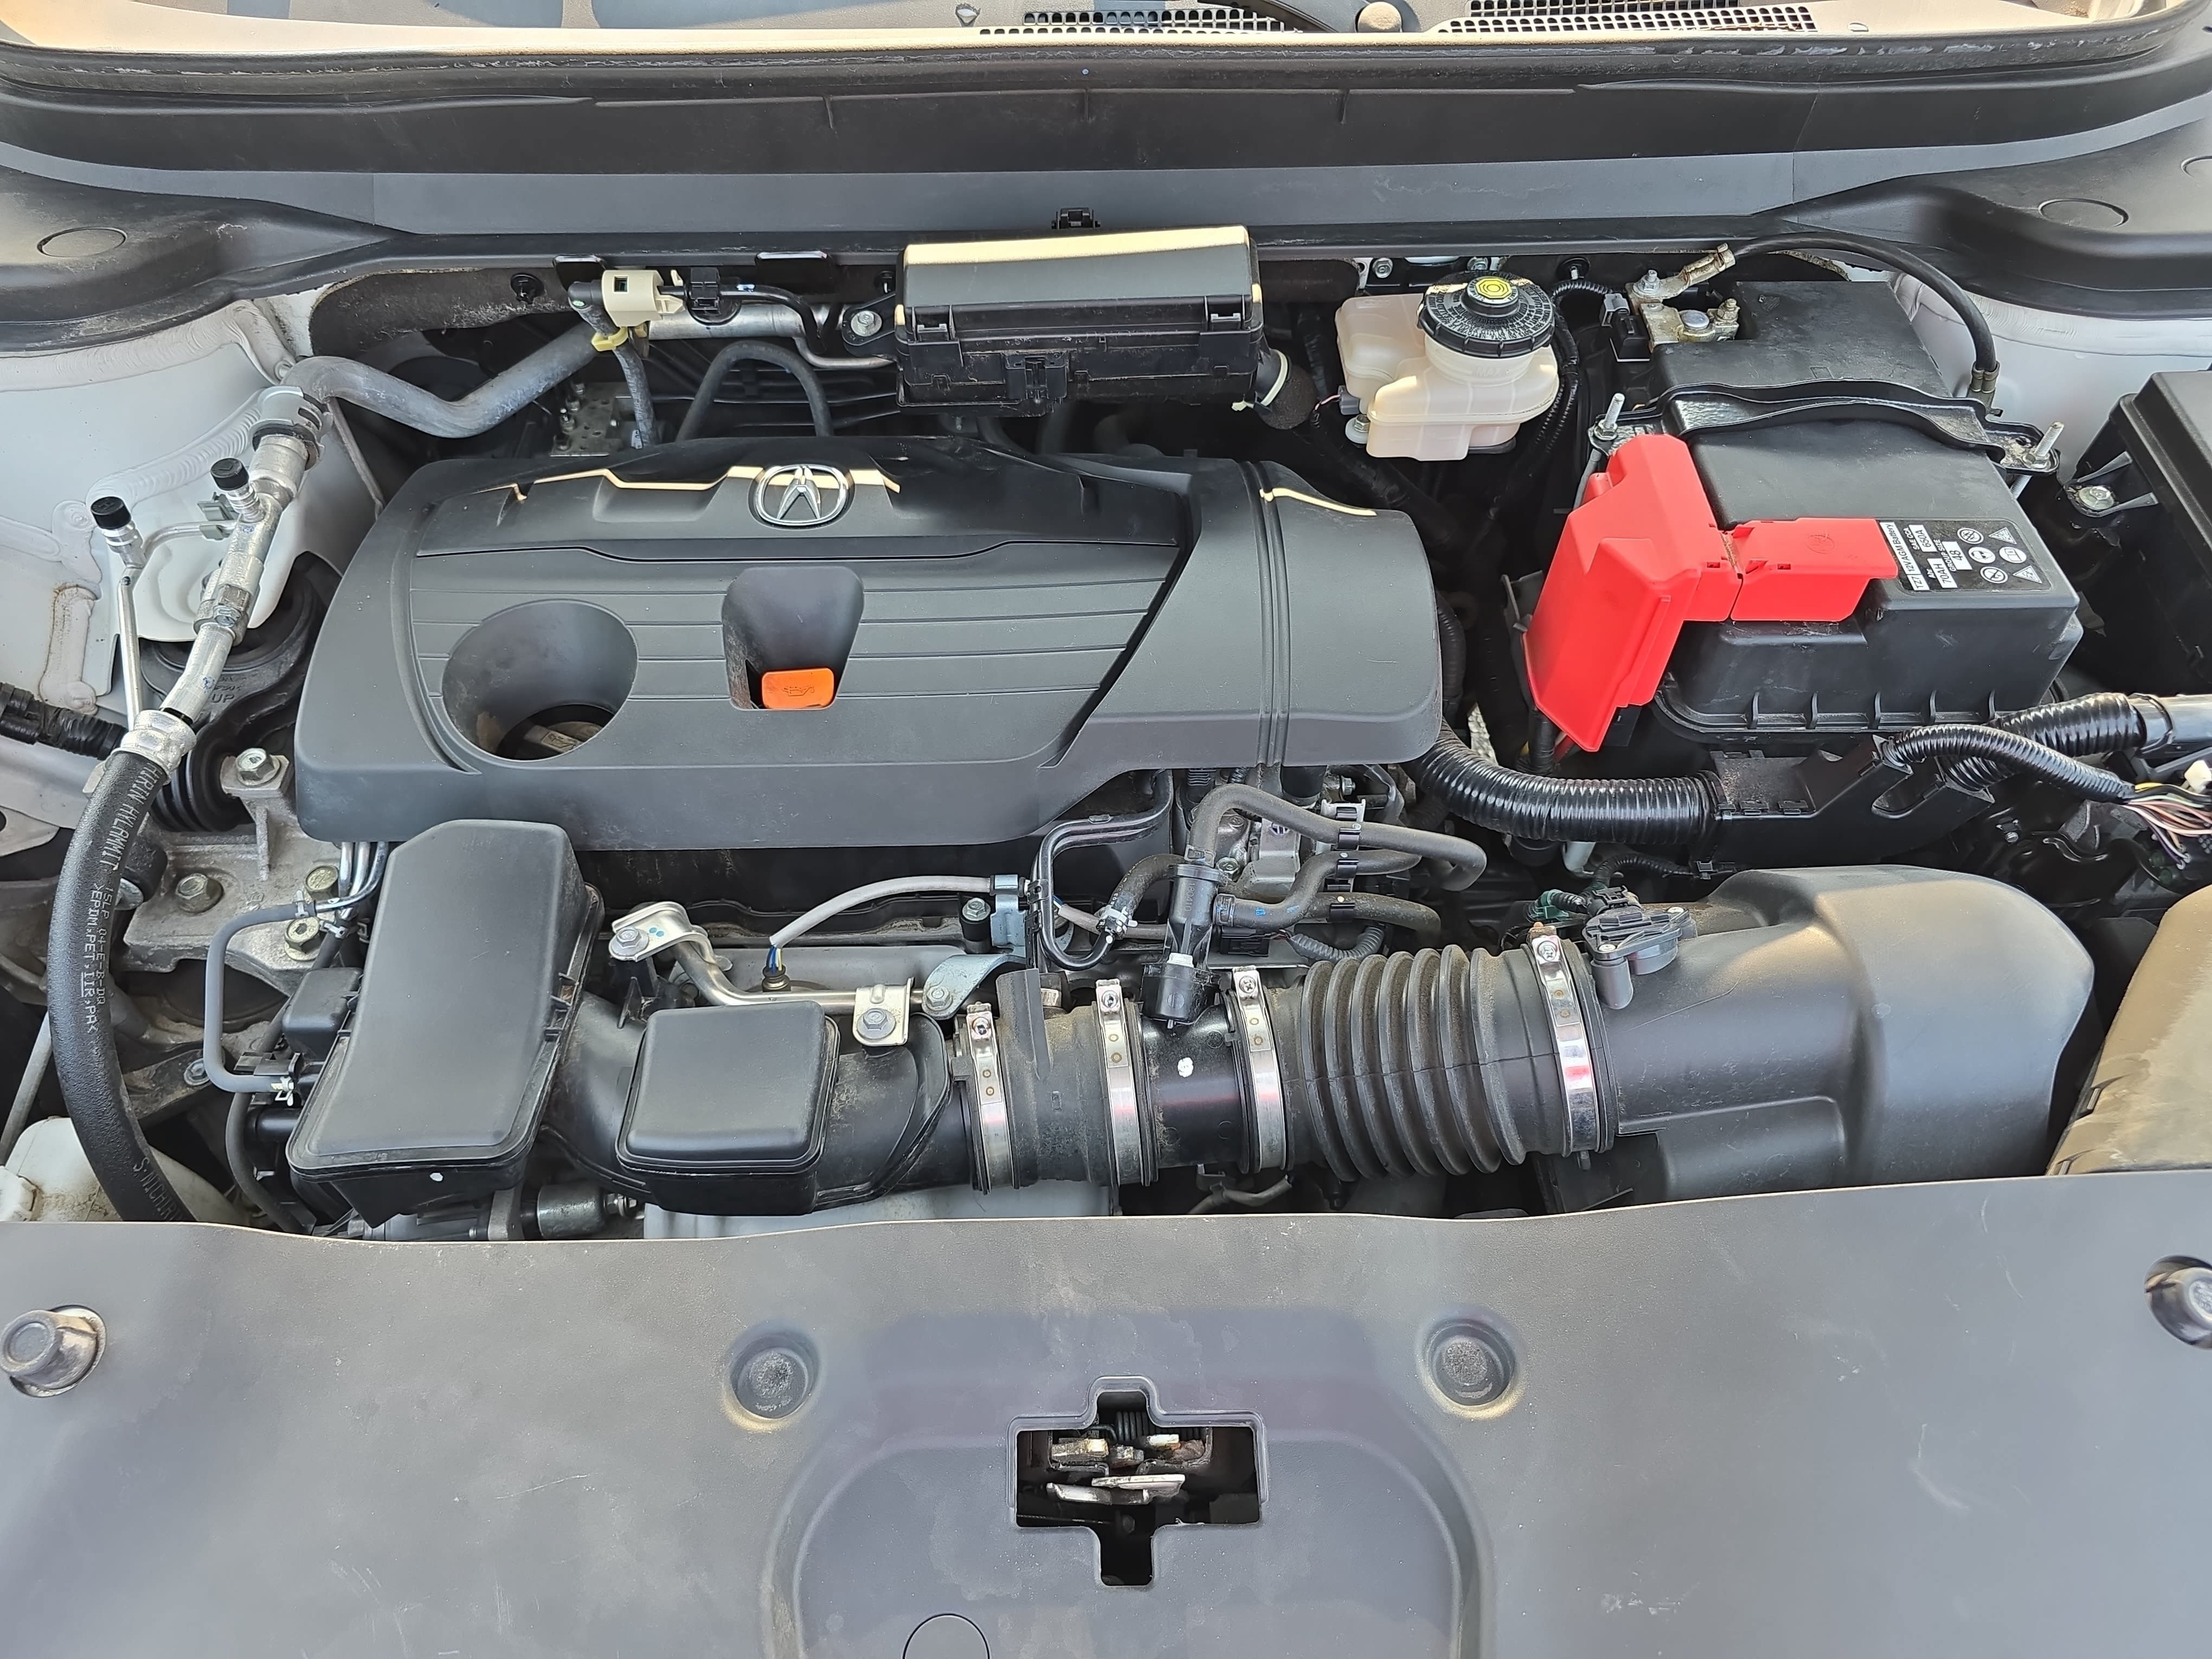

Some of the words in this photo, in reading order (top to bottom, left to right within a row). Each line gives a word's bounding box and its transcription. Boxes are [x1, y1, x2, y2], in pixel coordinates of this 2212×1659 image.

[1886, 524, 1901, 544] Battery
[1903, 528, 1914, 538] CCA
[1915, 530, 1931, 548] 650A
[1909, 539, 1920, 550] SAE
[1933, 539, 1945, 551] SIZE
[1895, 545, 1910, 561] AGM
[1949, 550, 1963, 561] 48
[1904, 561, 1915, 572] 12V
[1940, 552, 1957, 572] GROUP
[1933, 563, 1952, 583] 70AH
[212, 693, 235, 703] UP
[100, 803, 139, 871] HYLAMMIT
[1184, 883, 1195, 911] 180410
